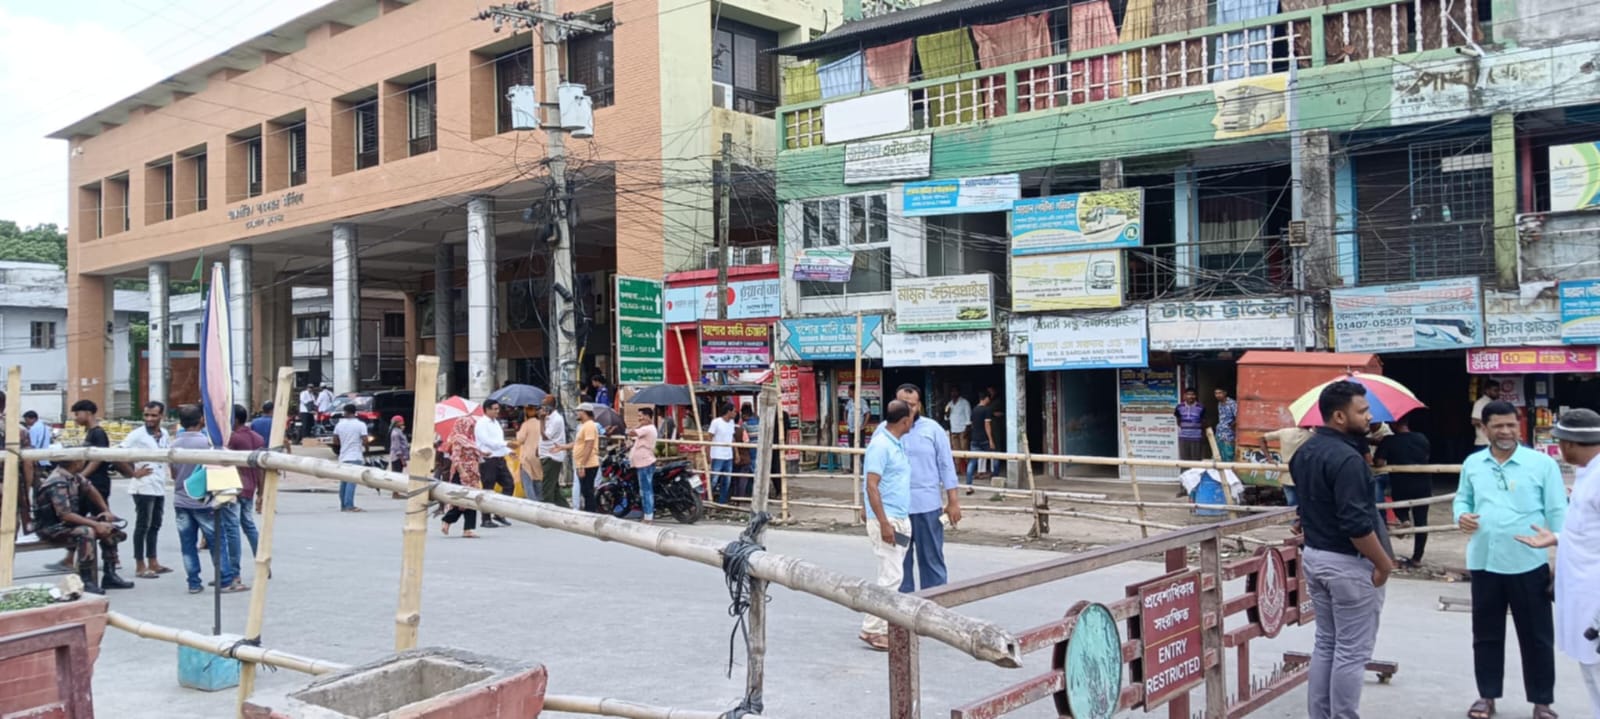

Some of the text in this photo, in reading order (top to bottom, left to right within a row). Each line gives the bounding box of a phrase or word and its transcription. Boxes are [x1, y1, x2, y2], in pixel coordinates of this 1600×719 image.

[897, 281, 989, 304] মামুন এন্টারপ্রাইজ
[1161, 302, 1215, 321] টাইম
[703, 325, 726, 336] যশোর
[727, 322, 744, 336] মানি
[1336, 317, 1413, 330] 01407-052557
[1472, 361, 1499, 370] ডাবল
[1144, 581, 1195, 608] প্রবেশাধিকার
[1153, 608, 1190, 631] সংরক্ষিত
[1158, 638, 1188, 664] ENTRY
[1146, 656, 1200, 695] RESTRICTED
